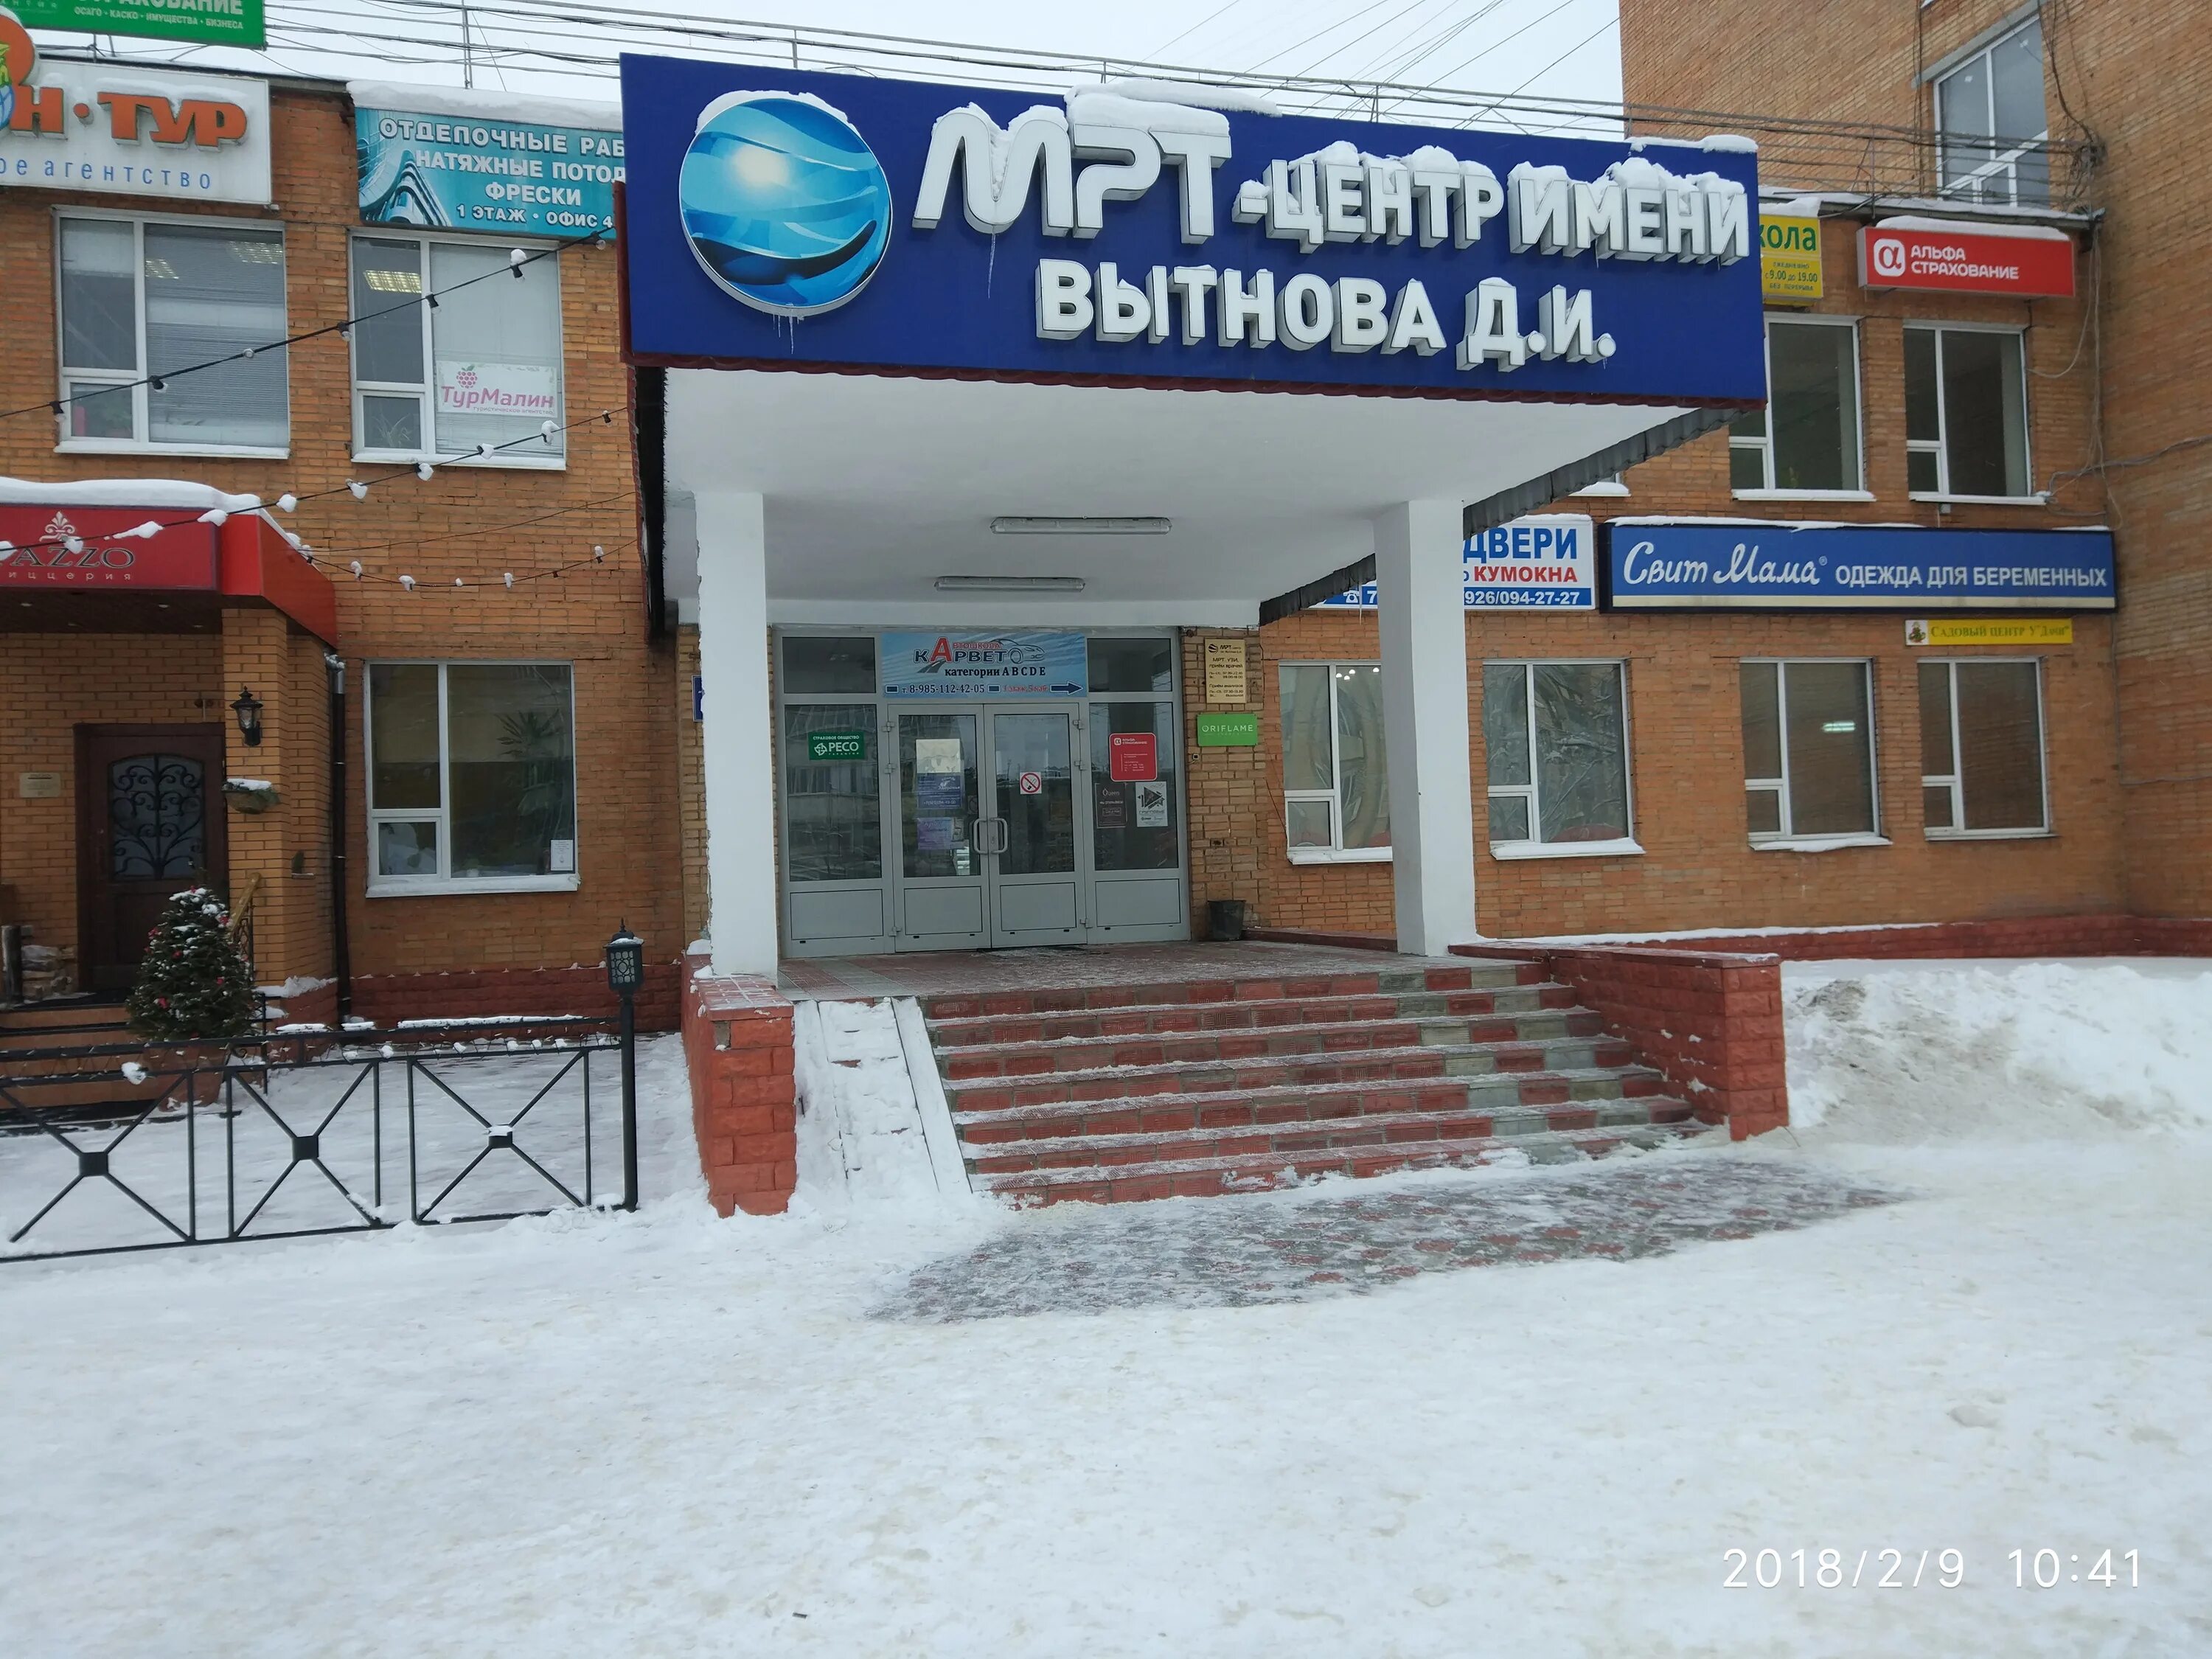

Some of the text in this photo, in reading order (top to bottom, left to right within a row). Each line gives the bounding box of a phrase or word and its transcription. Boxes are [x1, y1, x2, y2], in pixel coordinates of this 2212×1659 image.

[111, 10, 139, 20] КАСКО
[146, 13, 198, 25] ИМУЩЕСТВА
[206, 18, 243, 29] БИЗНЕСА
[580, 136, 625, 158] РАБ
[44, 159, 211, 189] агентство
[416, 150, 625, 184] НАТЯЖНЫЕ ПОТОЛ
[485, 182, 581, 206] ФРЕСКИ
[456, 204, 466, 218] 1
[473, 206, 526, 223] ЭТАЖ
[546, 211, 598, 229] ОФИС
[1508, 175, 1750, 266] ИМЕНИ
[1910, 245, 1966, 261] АЛЬФА
[1798, 271, 1818, 282] 19.00
[1910, 260, 2020, 280] СТРАХОВАНИЕ
[1035, 258, 1616, 372] ВЫТНОВА Д.И.
[441, 386, 554, 408] ТурМалин
[0, 546, 135, 569] AZZO
[1624, 541, 1708, 585] Свит
[1835, 565, 1923, 588] ОДЕЖДА
[1927, 566, 1967, 588] ДЛЯ
[1973, 566, 2107, 587] БЕРЕМЕННЫХ
[8, 571, 131, 581] иццерия
[1474, 566, 1578, 582] КУМОКНА
[1463, 591, 1580, 605] 926/094-27-27
[945, 667, 1000, 678] категории
[909, 684, 985, 694] 8-985-112-42-05
[1201, 724, 1254, 732] ORIFLAME
[828, 742, 859, 752] РЕСО
